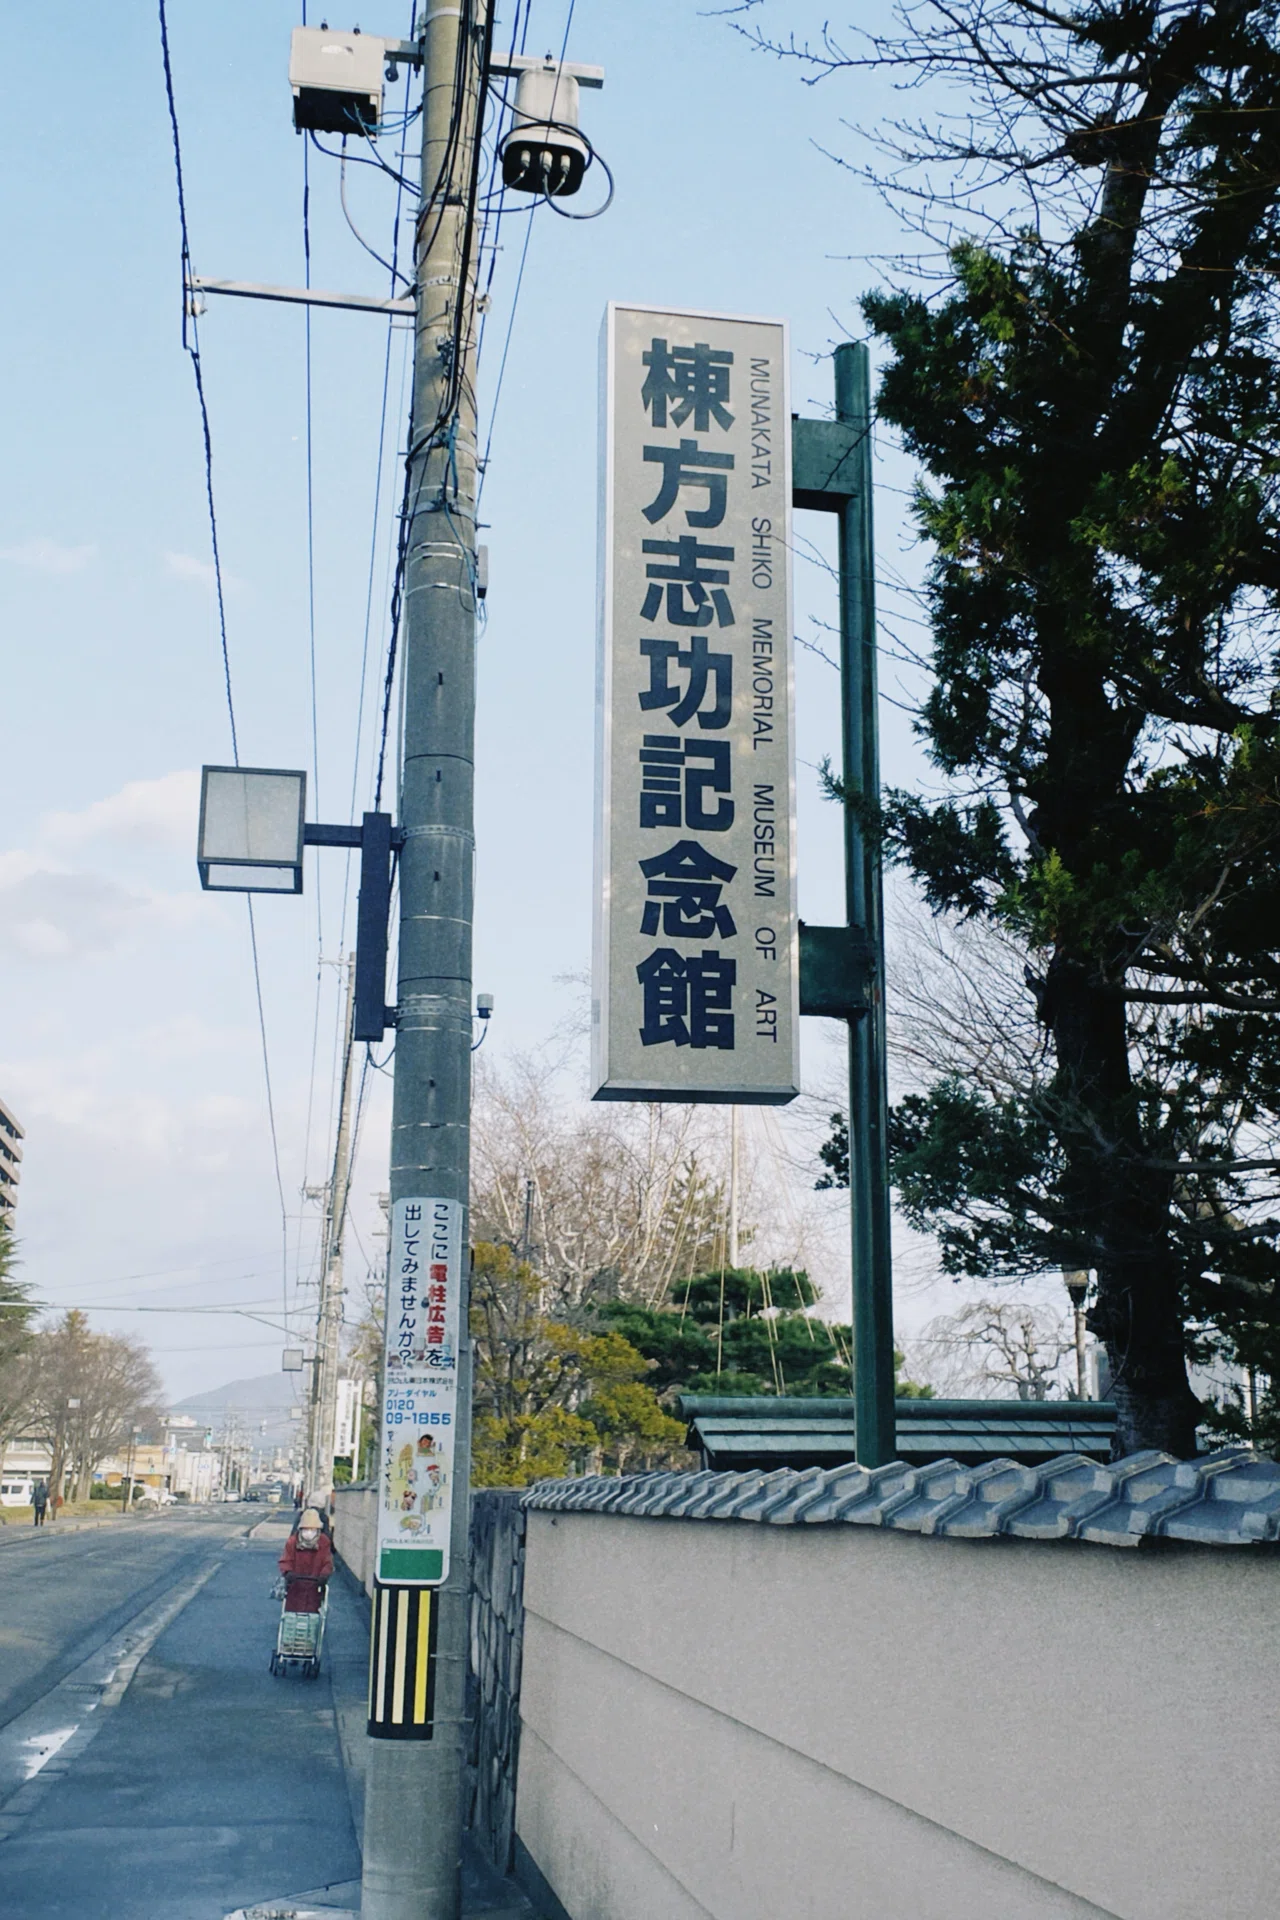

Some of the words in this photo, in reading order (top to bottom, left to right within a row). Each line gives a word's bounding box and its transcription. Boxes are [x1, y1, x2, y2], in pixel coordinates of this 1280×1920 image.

[750, 358, 771, 489] MUNAKATA
[751, 516, 772, 590] SHIKO
[636, 338, 738, 1050] 棟方志功記念館
[752, 618, 773, 751] MEMORIAL
[753, 784, 775, 897] MUSEUM
[754, 926, 776, 961] OF
[755, 988, 777, 1043] ART
[425, 1204, 449, 1367] ここに電柱広告を
[386, 1399, 415, 1410] 0120
[386, 1412, 452, 1425] 09-1855
[387, 1389, 437, 1397] フリーダイヤル
